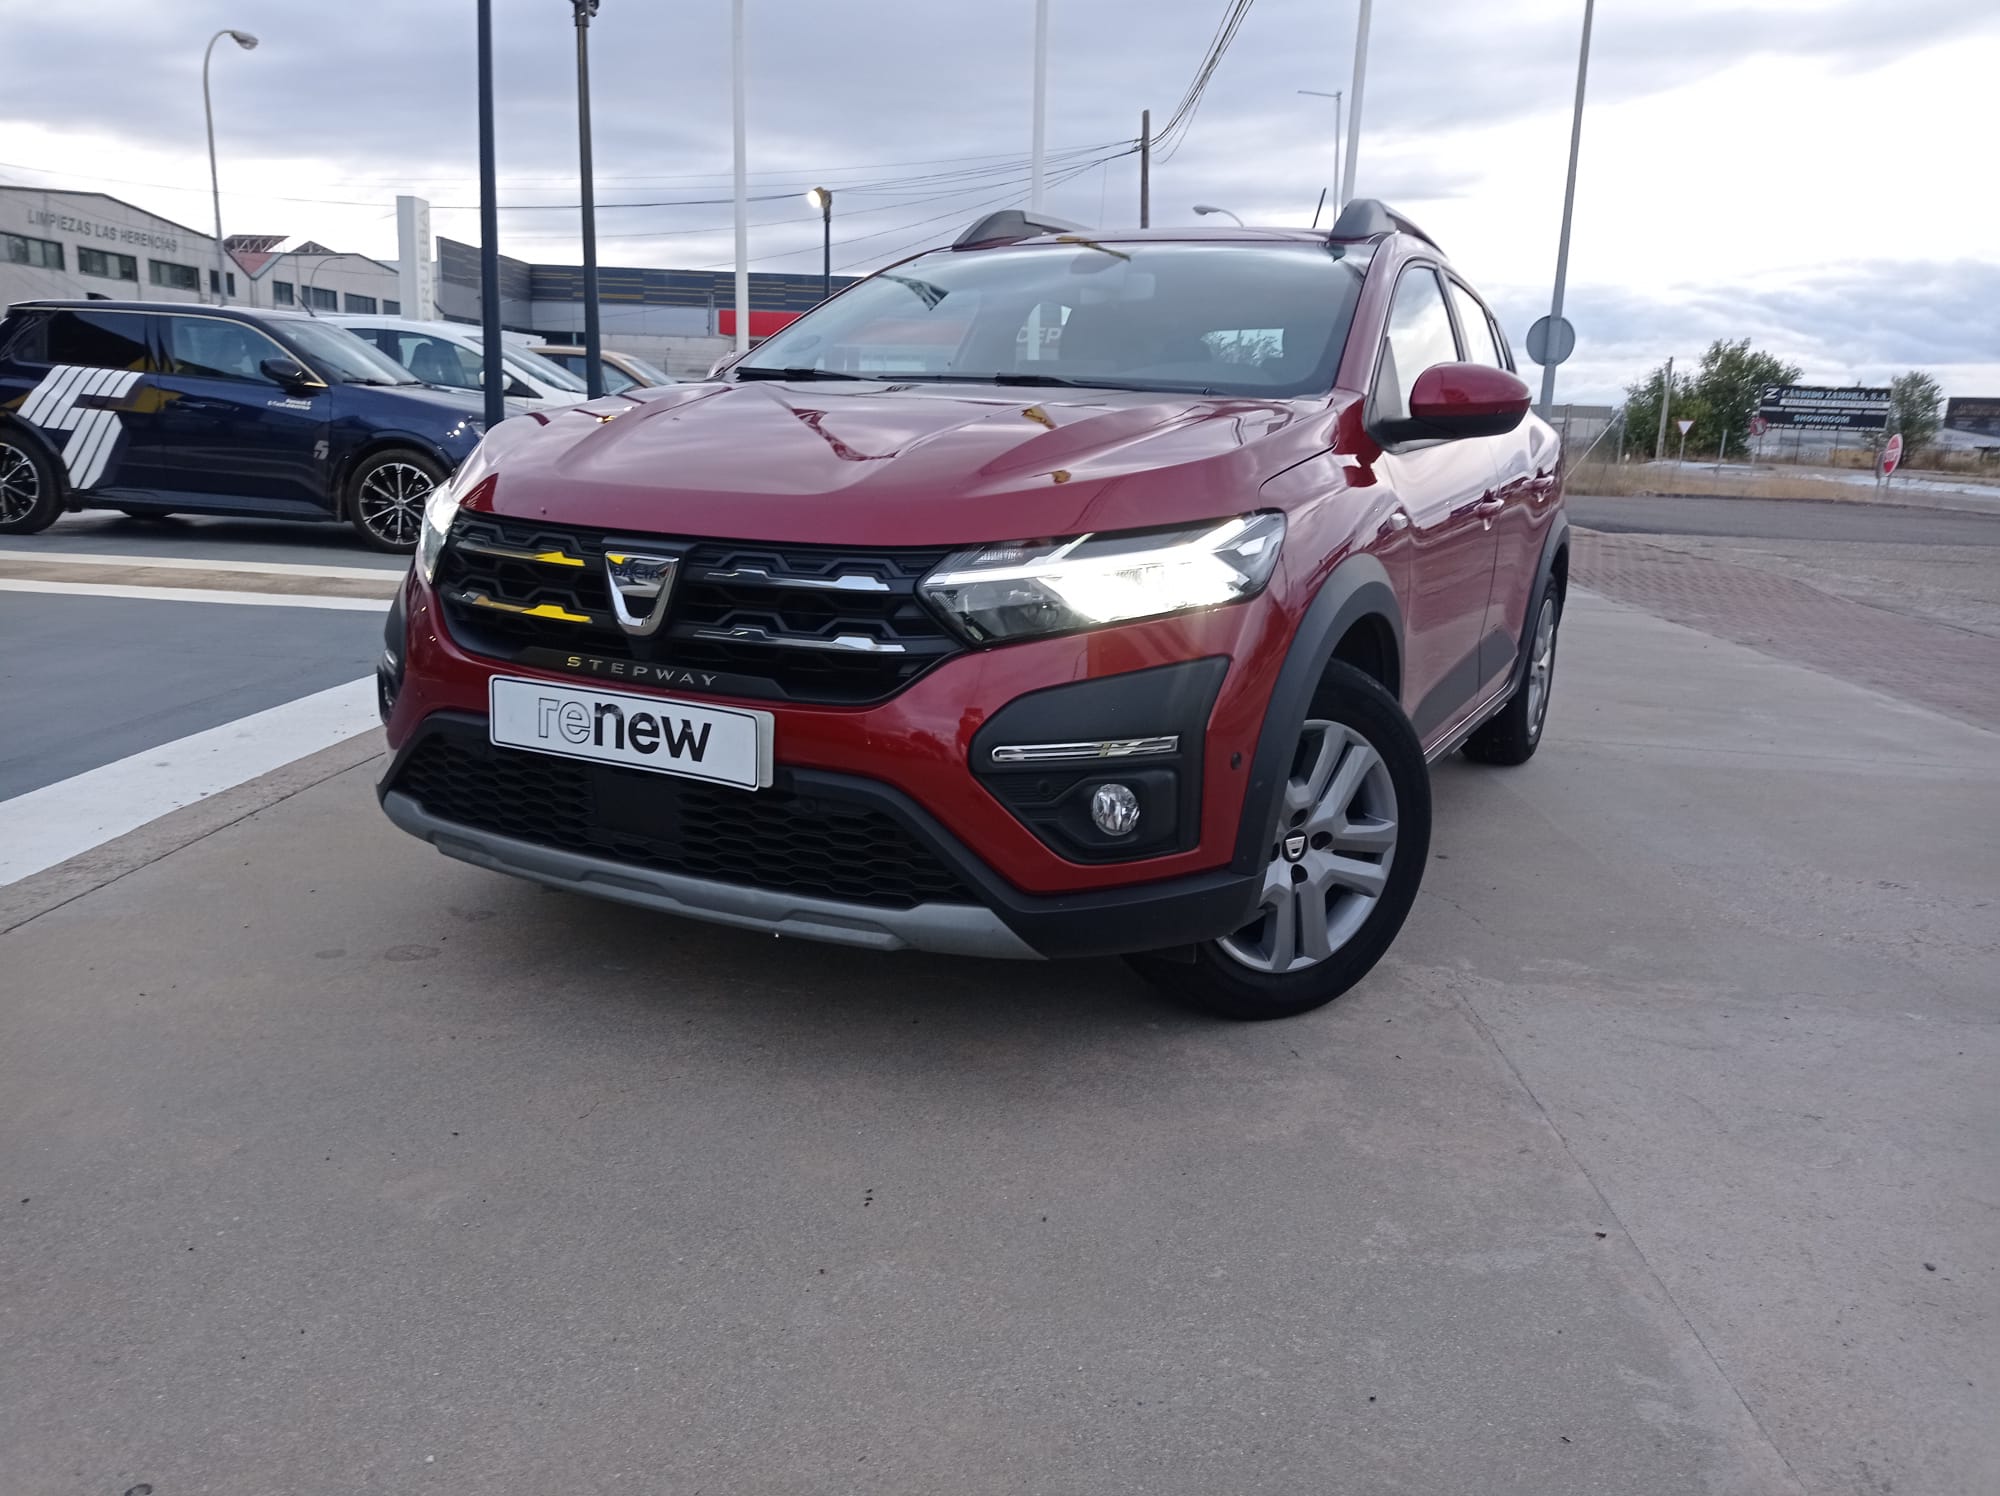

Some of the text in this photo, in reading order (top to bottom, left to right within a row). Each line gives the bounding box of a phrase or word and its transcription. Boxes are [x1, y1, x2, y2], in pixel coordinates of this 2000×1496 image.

[28, 209, 177, 252] LIMPIEZAS LAS HERENCIAS
[1793, 414, 1851, 424] SHOWROOM
[567, 656, 717, 687] STEPWAY
[538, 697, 712, 763] renew
